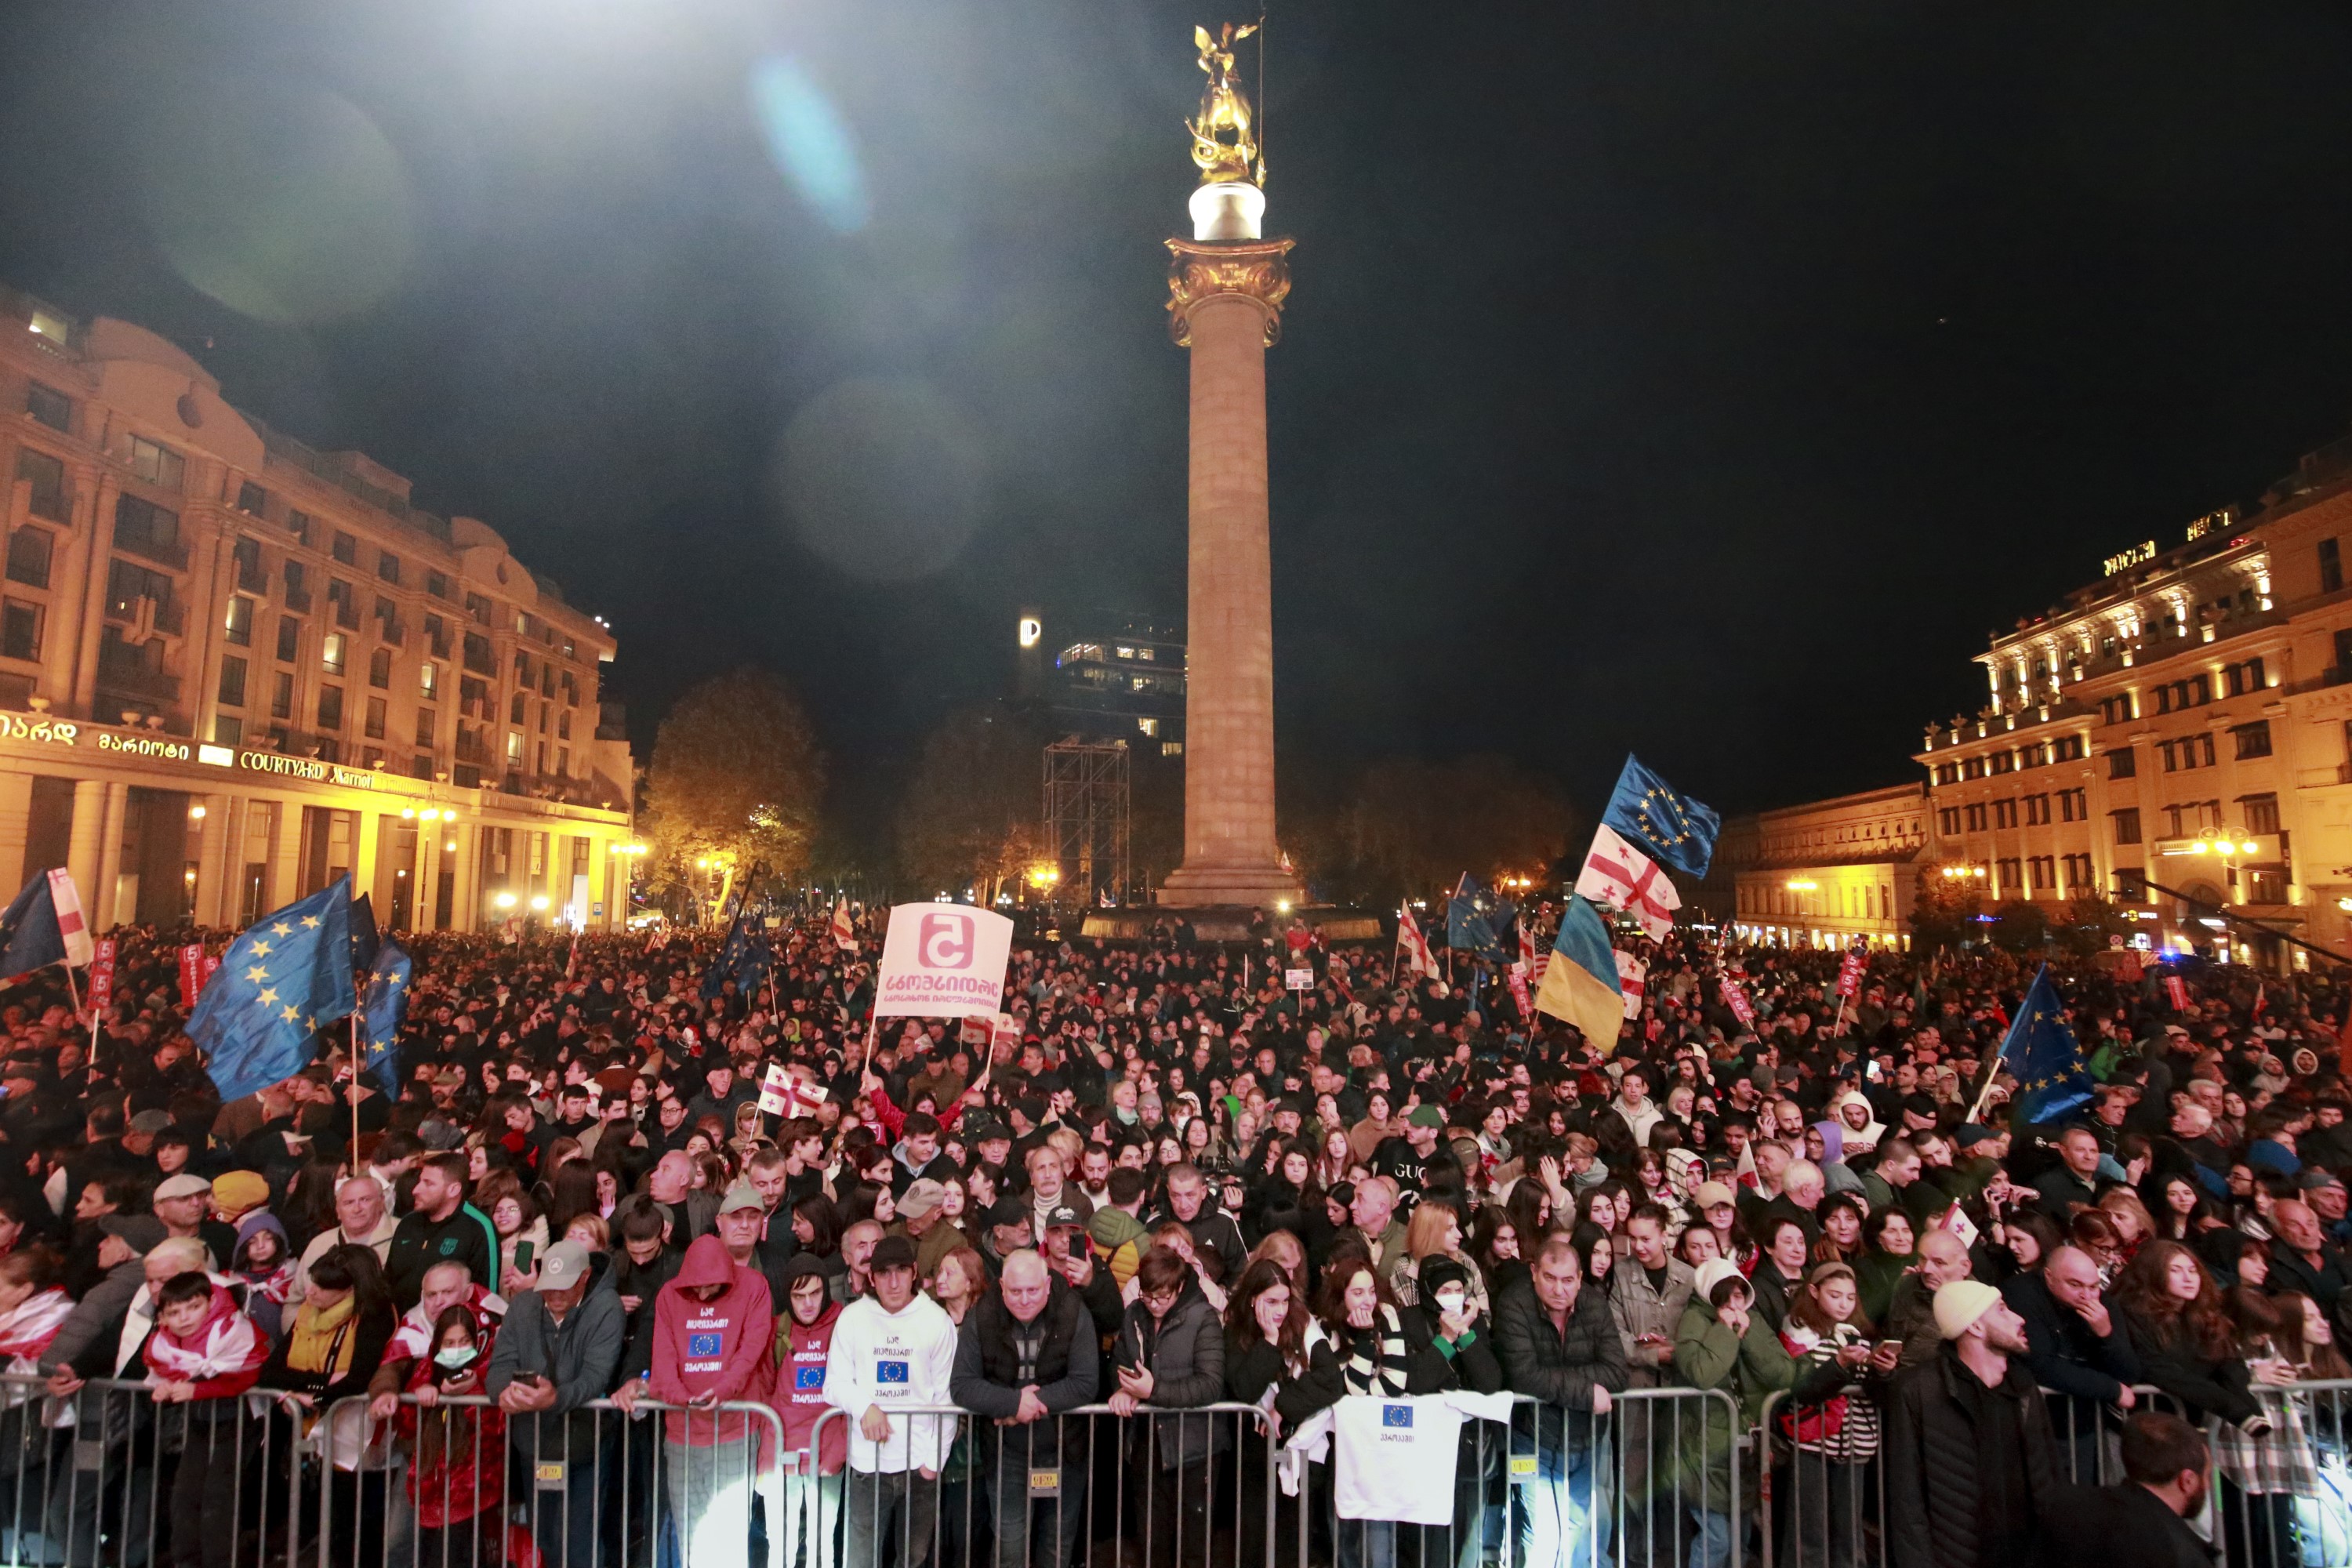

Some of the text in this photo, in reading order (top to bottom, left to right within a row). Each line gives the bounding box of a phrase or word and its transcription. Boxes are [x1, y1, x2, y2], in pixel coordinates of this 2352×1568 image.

[98, 734, 189, 760] მარიოტი
[240, 751, 324, 779] COURTYARD
[100, 941, 111, 957] 5
[187, 946, 198, 960] 5
[1848, 956, 1857, 965] 5
[96, 975, 106, 991] 5
[1843, 975, 1853, 985] 5
[1735, 1001, 1744, 1011] 5
[700, 1307, 714, 1316] სად
[808, 1340, 821, 1350] სად
